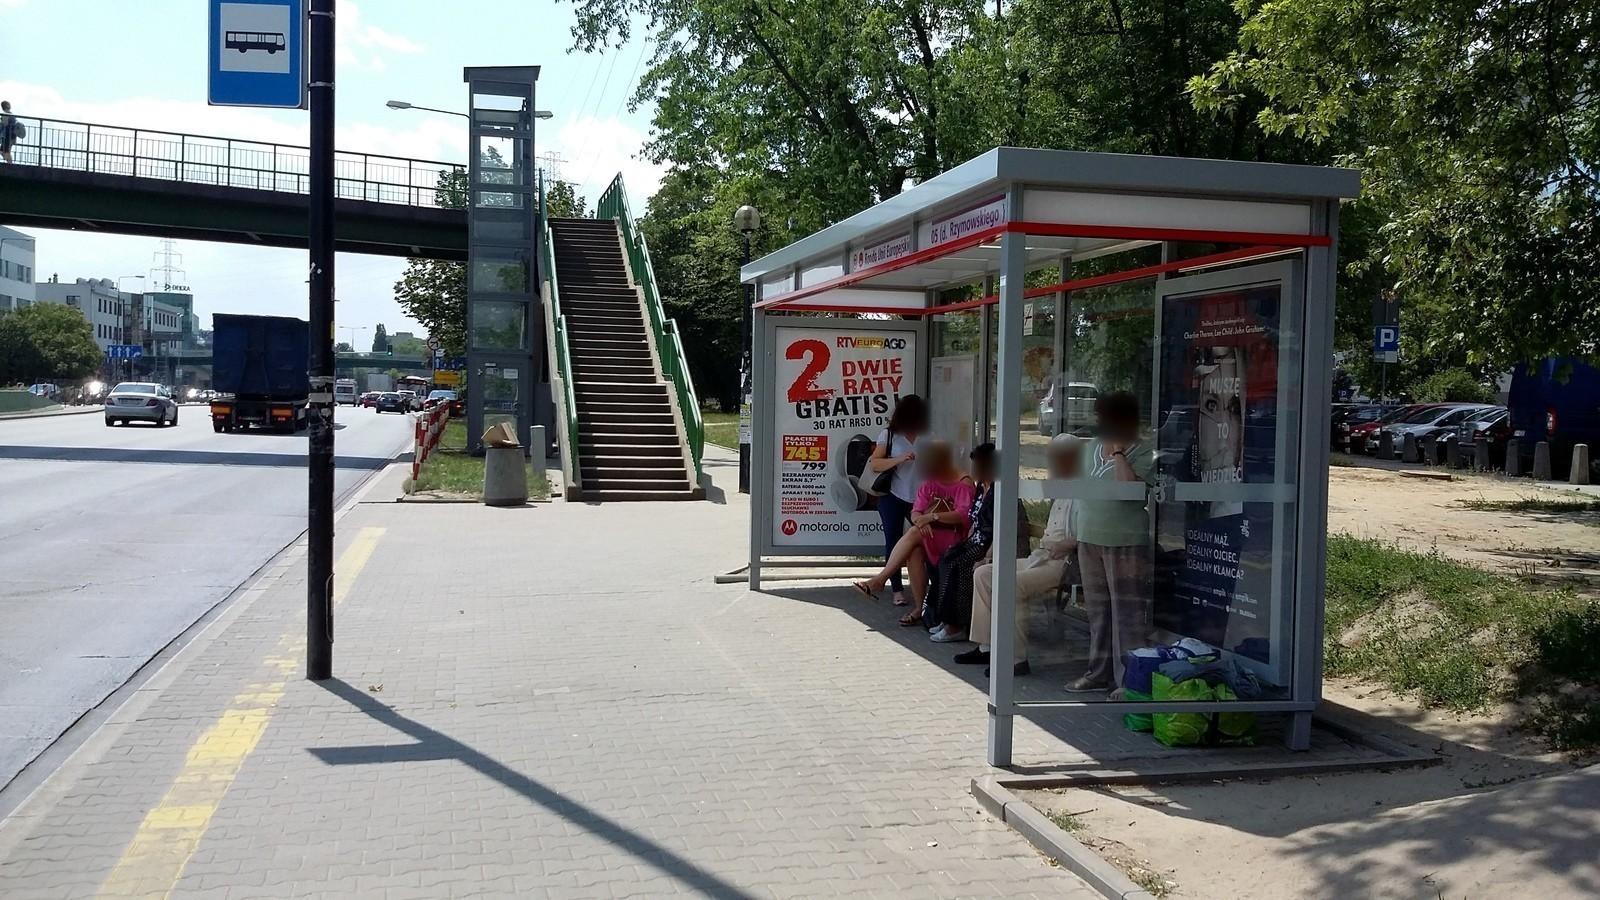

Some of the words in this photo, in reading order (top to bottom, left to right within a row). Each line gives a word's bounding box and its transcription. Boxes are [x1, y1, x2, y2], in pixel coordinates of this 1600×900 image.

[930, 228, 938, 244] 05
[949, 208, 1000, 238] Rzymowskiego
[864, 251, 877, 265] Rondo
[1380, 328, 1395, 348] P
[785, 339, 836, 403] 2
[841, 358, 902, 377] DWIE
[843, 376, 903, 396] RATY
[1209, 377, 1241, 397] MUSZĘ
[813, 420, 825, 430] 30
[829, 419, 846, 429] RAT
[849, 417, 871, 428] RRSO
[1217, 423, 1229, 439] TO
[785, 446, 821, 461] 745
[801, 462, 826, 471] 799
[1200, 461, 1243, 483] WIEDZIEĆ
[799, 521, 850, 532] motorola
